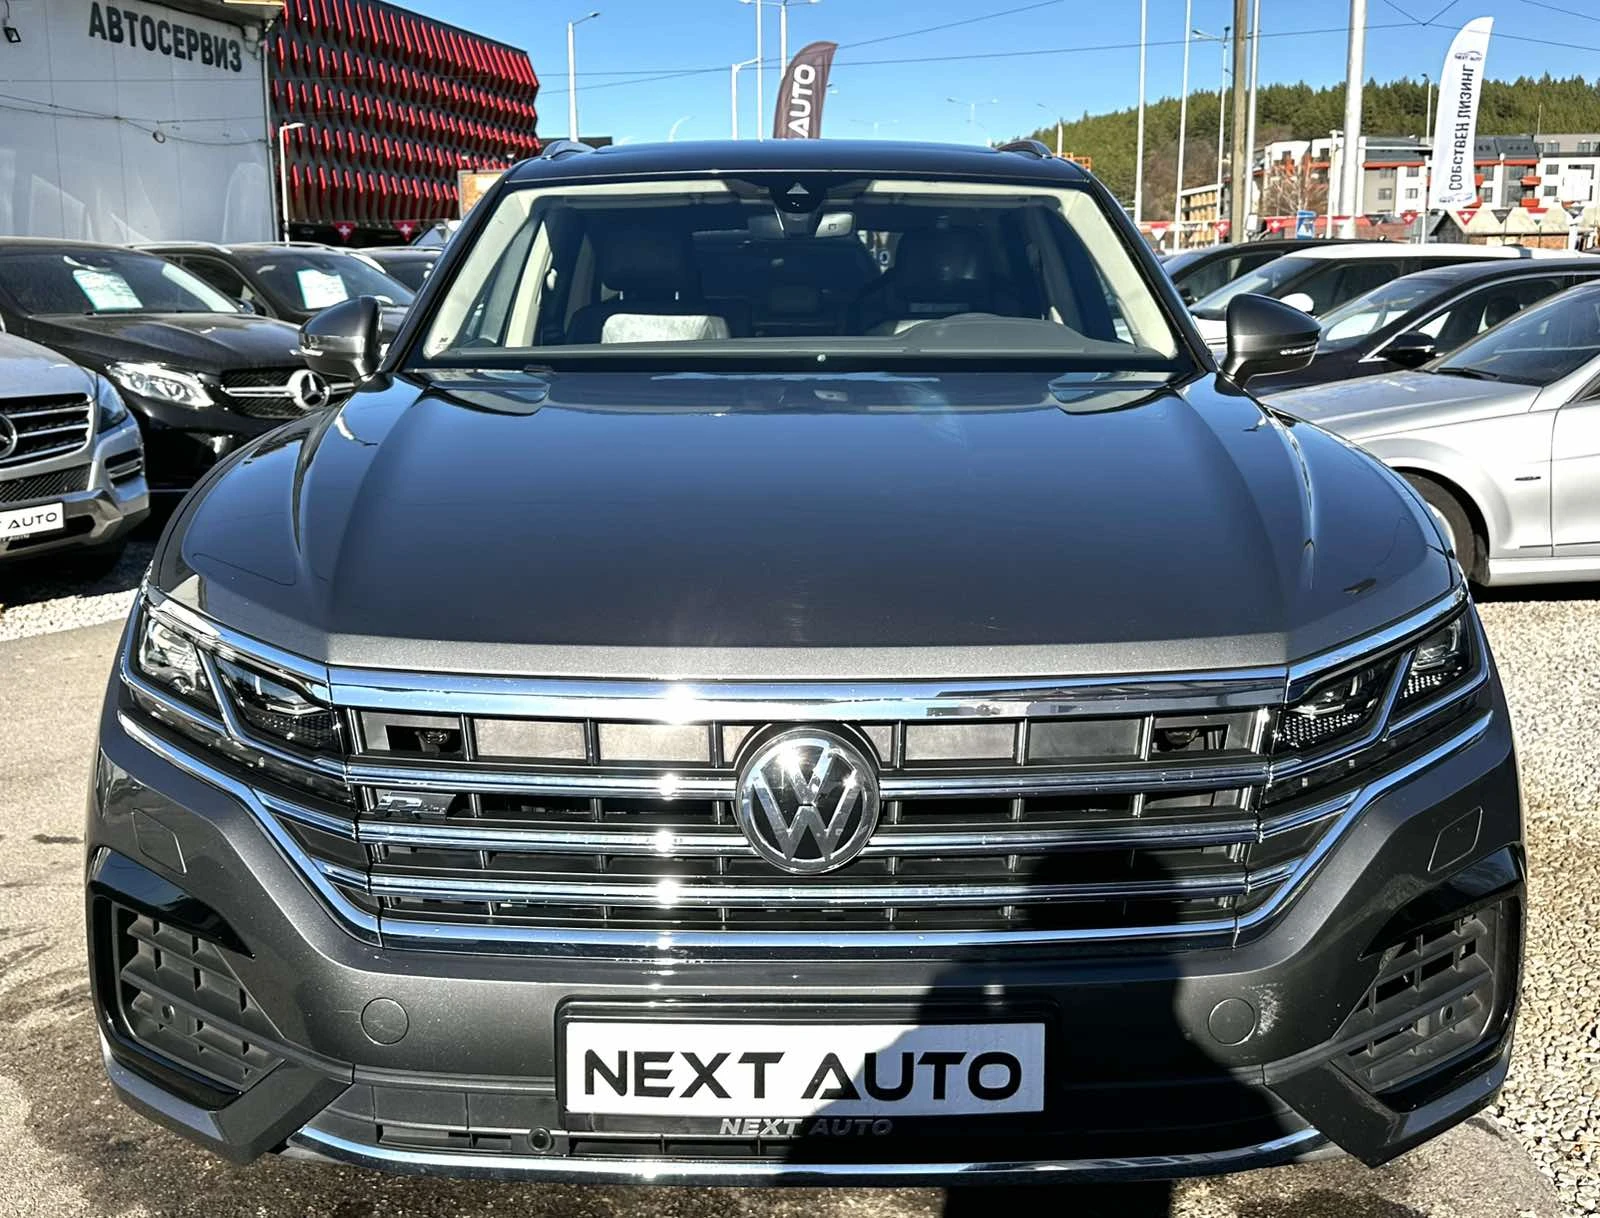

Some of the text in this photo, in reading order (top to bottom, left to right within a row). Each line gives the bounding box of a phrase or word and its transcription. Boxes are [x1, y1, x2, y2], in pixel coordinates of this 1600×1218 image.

[89, 1, 242, 73] АВТОСЕРВИЗ
[788, 64, 816, 138] AUTO
[1457, 63, 1475, 119] ЛИЗИНГ
[1449, 122, 1470, 191] СОБСТВЕН
[8, 512, 57, 529] AUTO
[584, 1049, 1022, 1101] NEXT AUTO
[719, 1118, 893, 1136] NEXT AUTO
